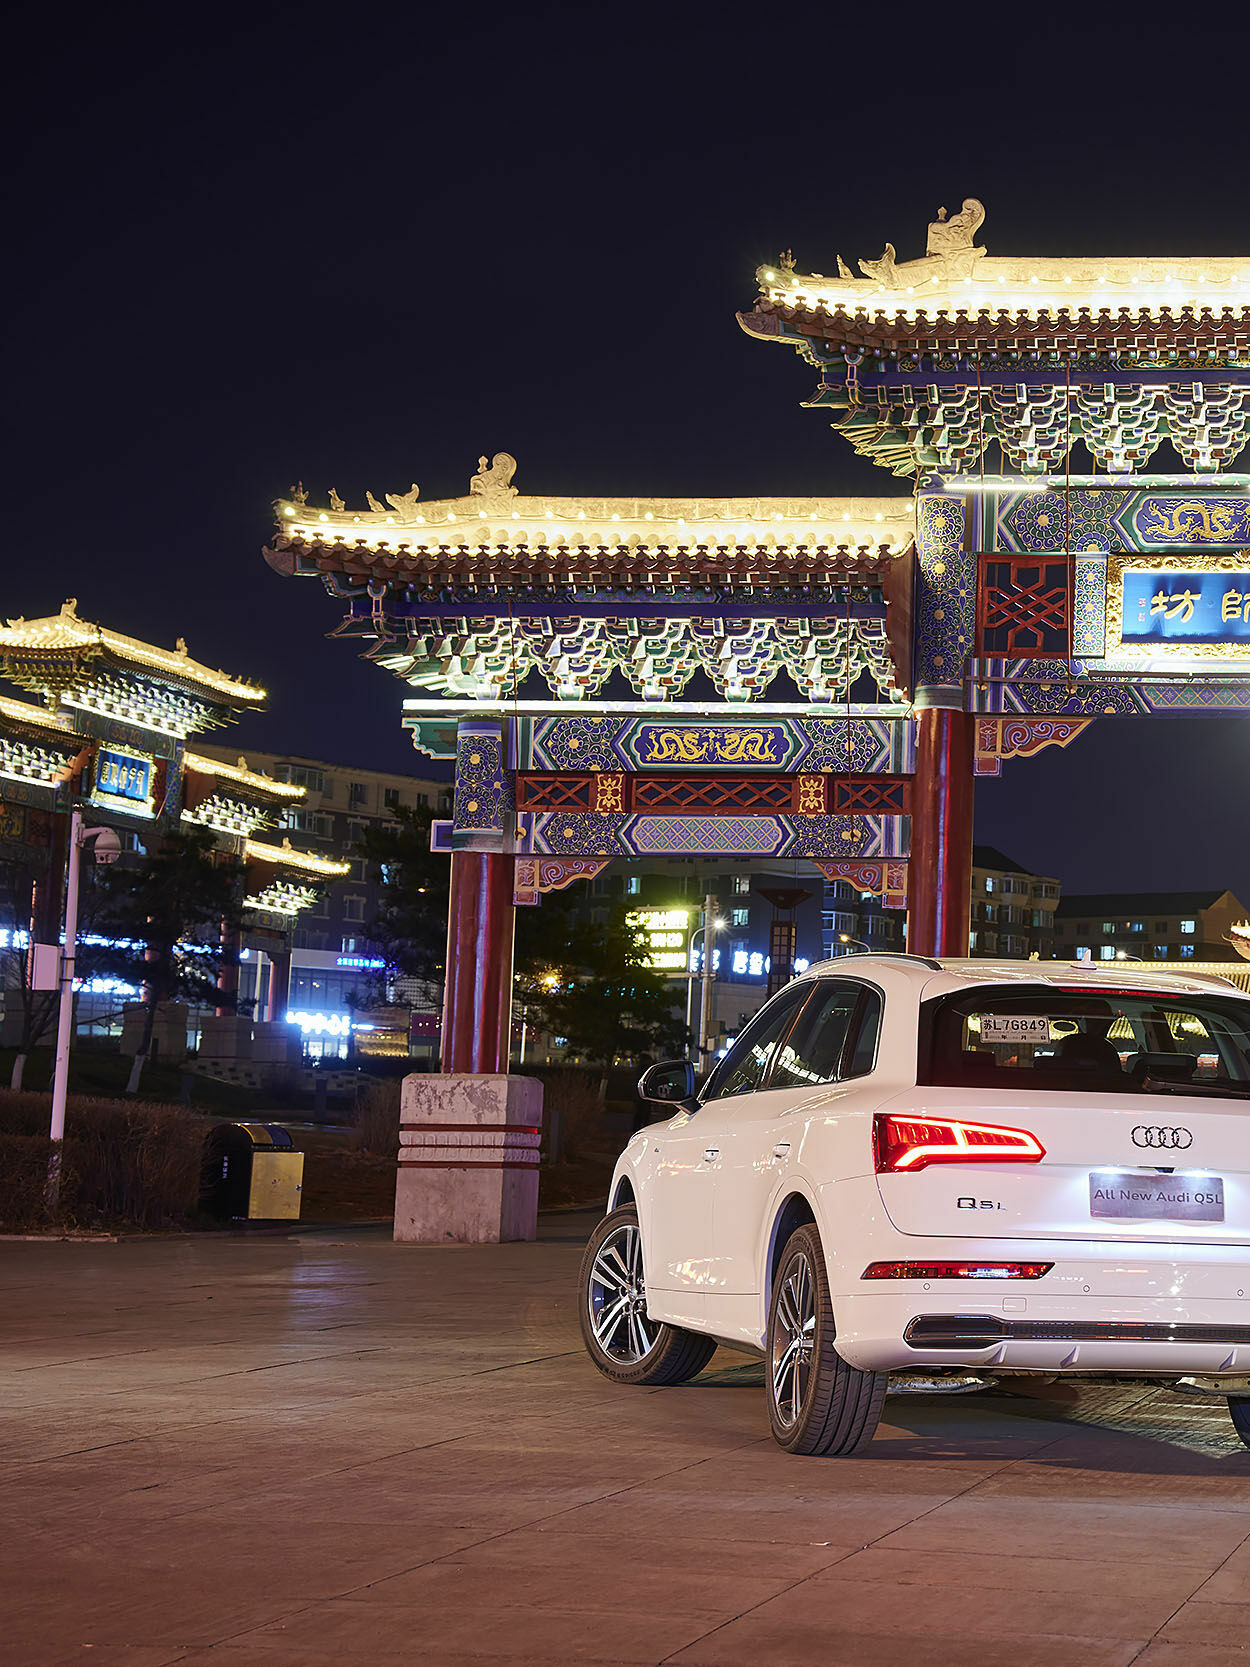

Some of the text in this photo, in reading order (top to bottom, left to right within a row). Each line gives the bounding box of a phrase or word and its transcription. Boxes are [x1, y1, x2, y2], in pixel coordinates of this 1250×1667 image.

[983, 1019, 1046, 1031] 苏L7G849
[957, 1197, 1006, 1210] Q5L
[1094, 1189, 1223, 1205] All New Audi Q5L
